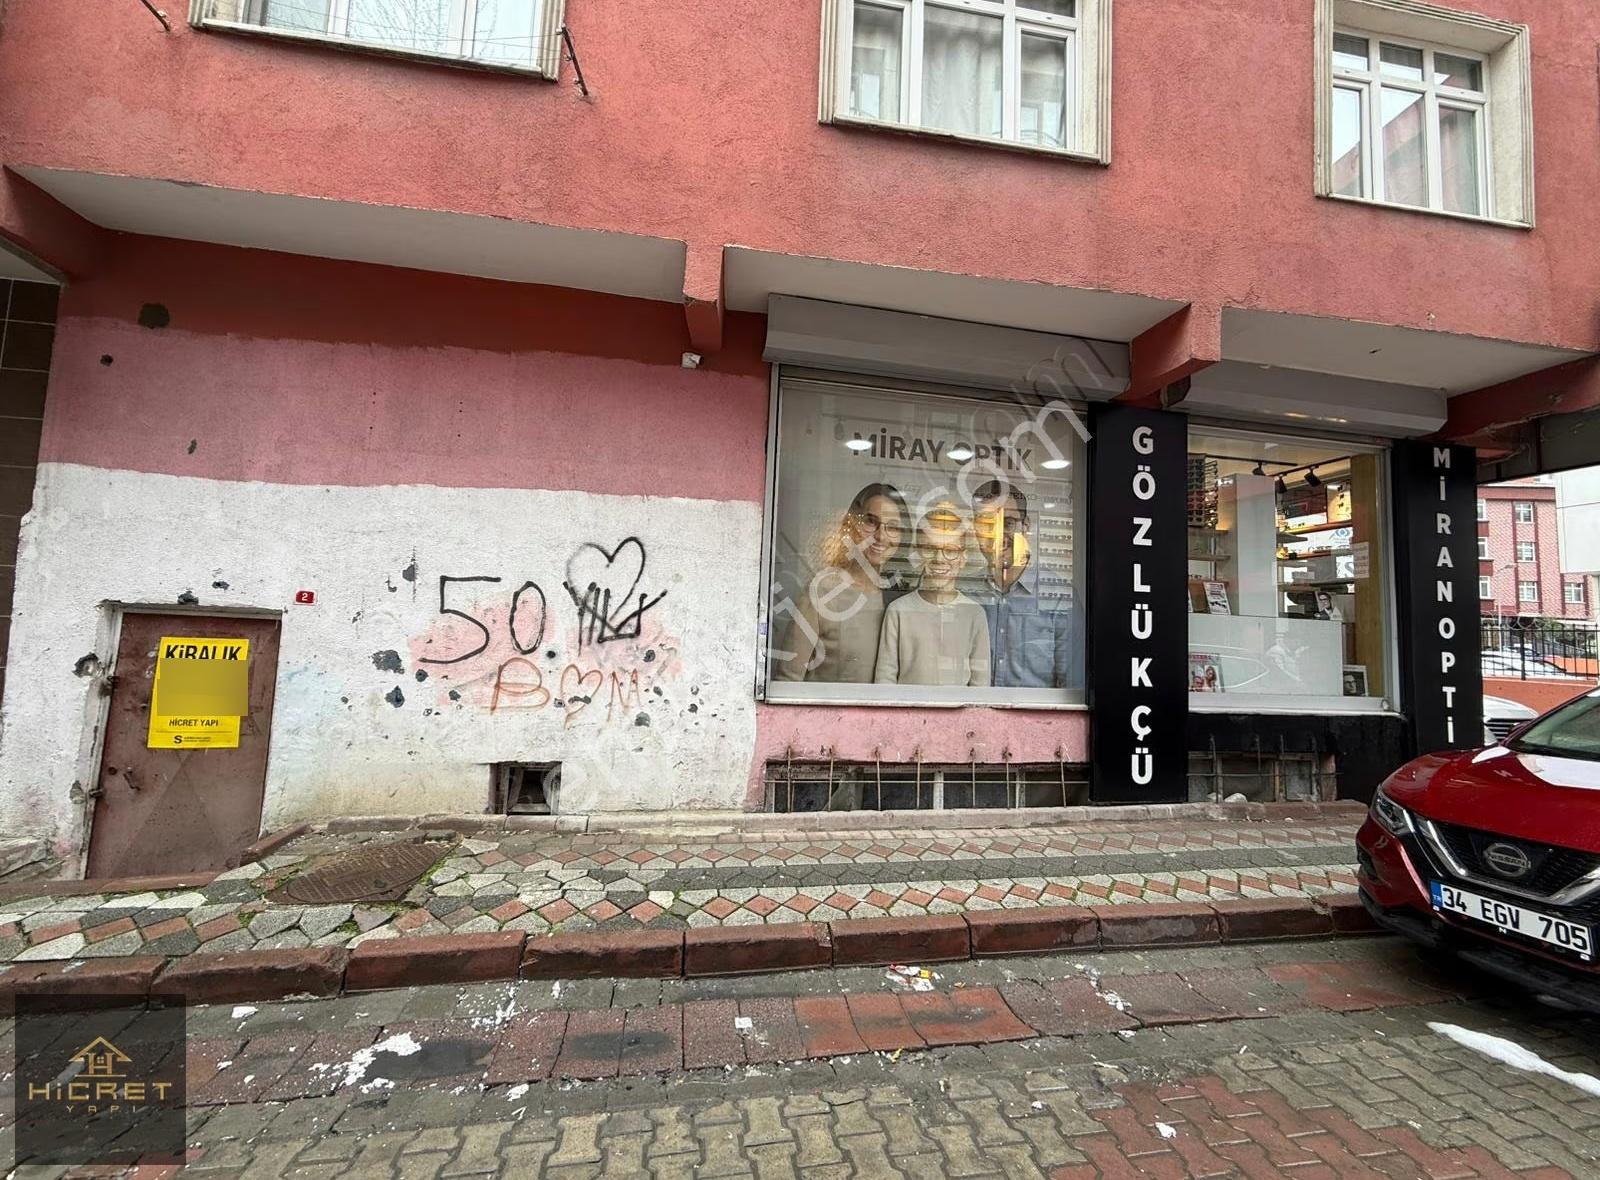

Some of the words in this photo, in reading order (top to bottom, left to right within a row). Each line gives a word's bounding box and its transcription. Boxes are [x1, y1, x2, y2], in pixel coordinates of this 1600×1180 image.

[853, 427, 945, 463] MİRAY
[301, 592, 309, 601] 2
[418, 575, 546, 664] 50
[1131, 426, 1156, 785] GÖZLÜKÇÜ
[1433, 447, 1457, 743] MİRANOPTİ
[169, 718, 199, 727] HİCRET
[1443, 887, 1467, 912] 34
[1480, 899, 1520, 930] EGV
[1538, 916, 1588, 950] 705
